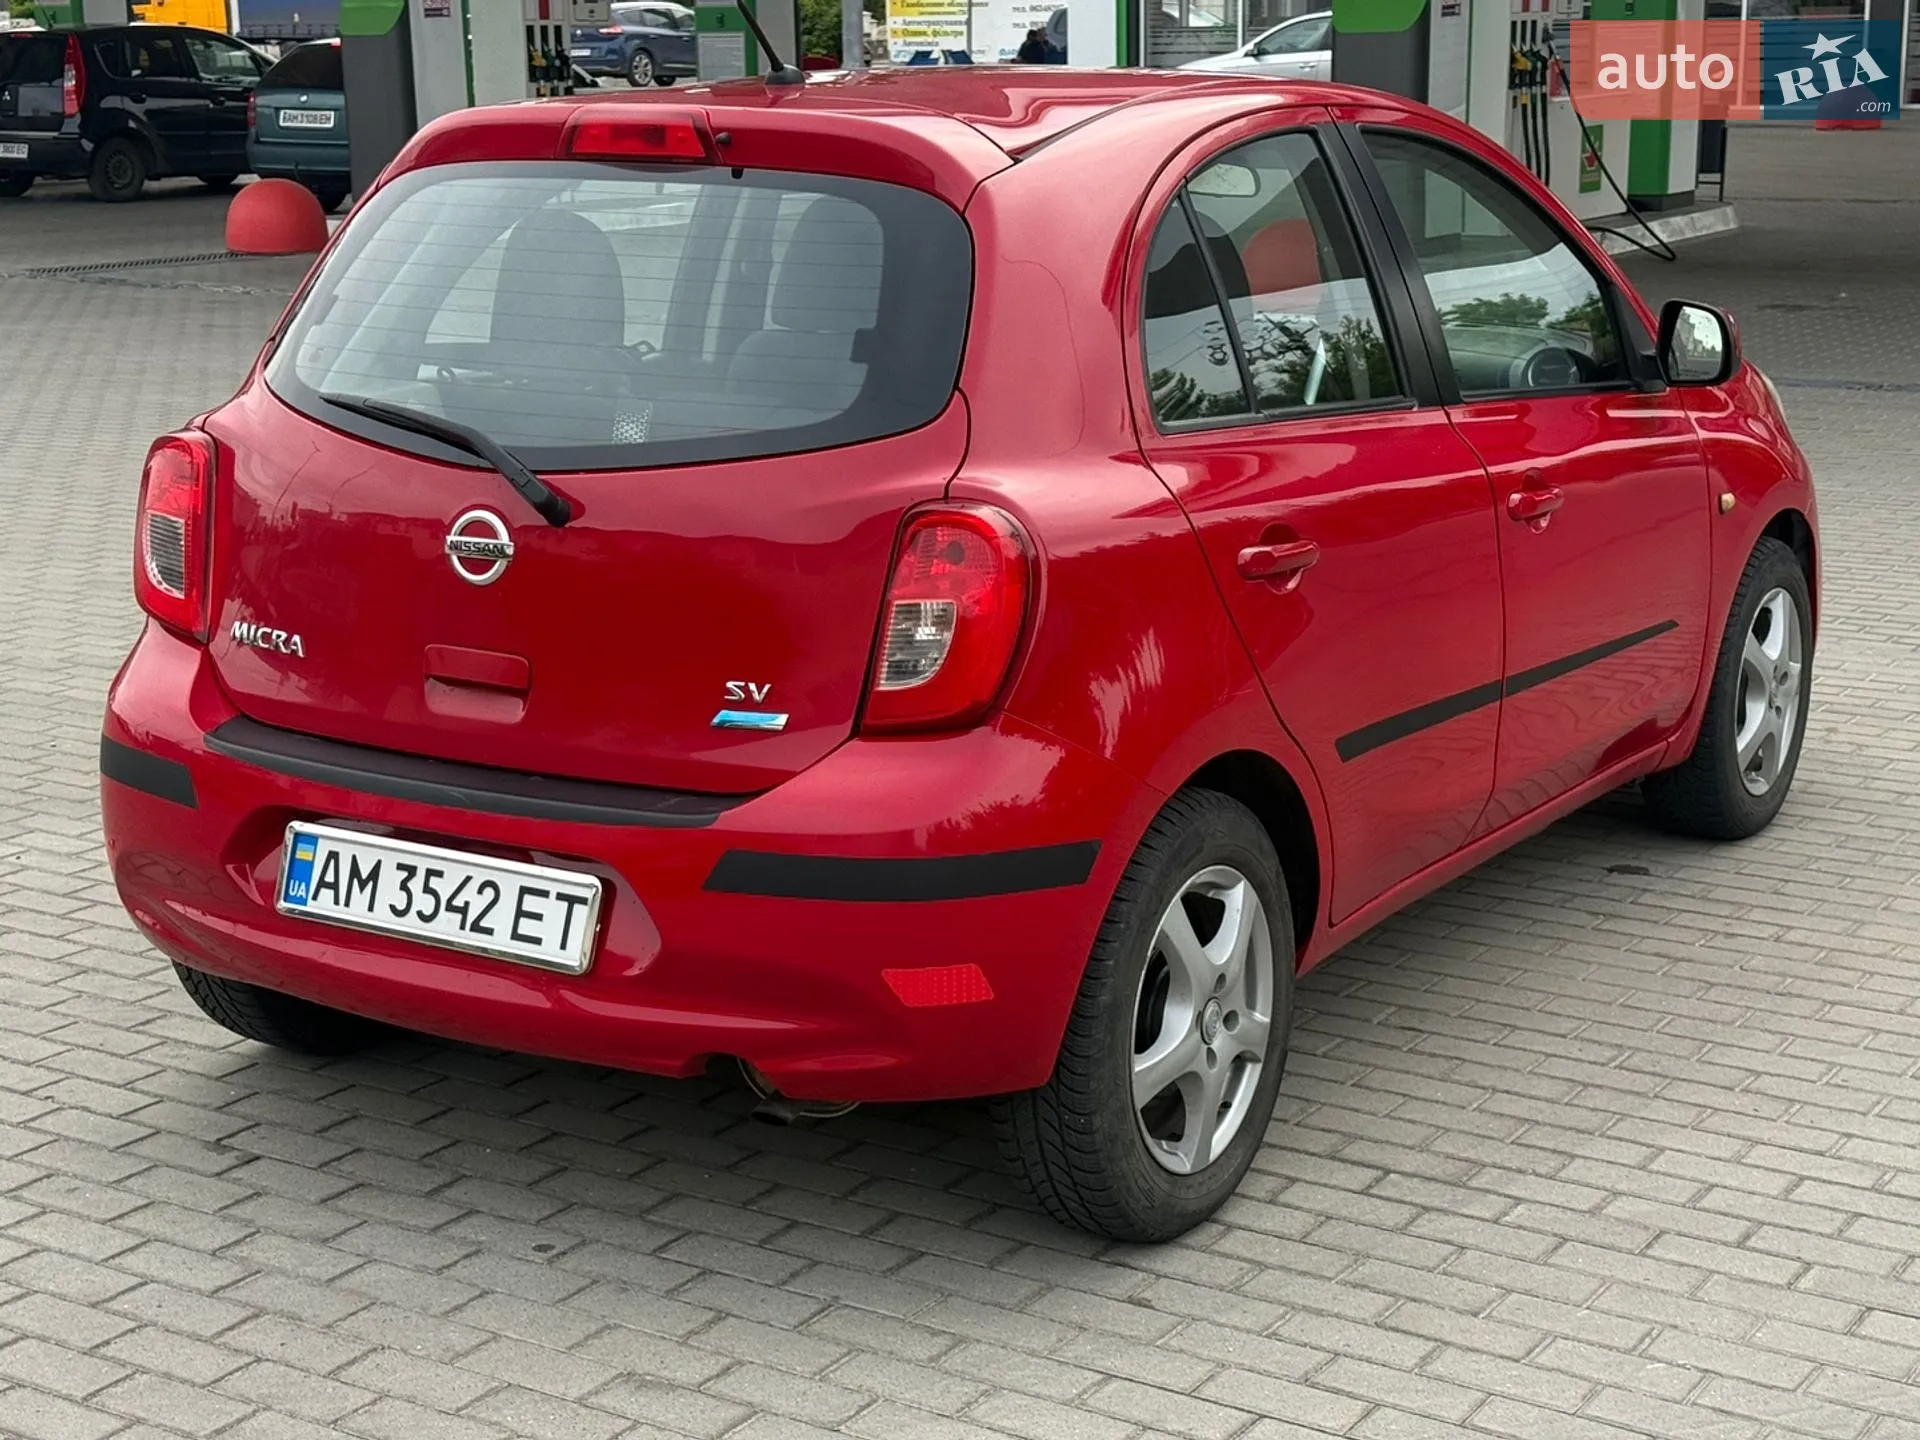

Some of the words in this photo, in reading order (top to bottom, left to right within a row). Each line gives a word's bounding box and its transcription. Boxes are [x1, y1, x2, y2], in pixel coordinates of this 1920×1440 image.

[449, 540, 509, 558] NISSAN
[230, 620, 305, 658] MICRA
[724, 681, 772, 703] SV
[289, 879, 306, 898] UA
[311, 850, 382, 912] AM
[388, 862, 502, 936] 3542
[510, 885, 589, 950] ET
